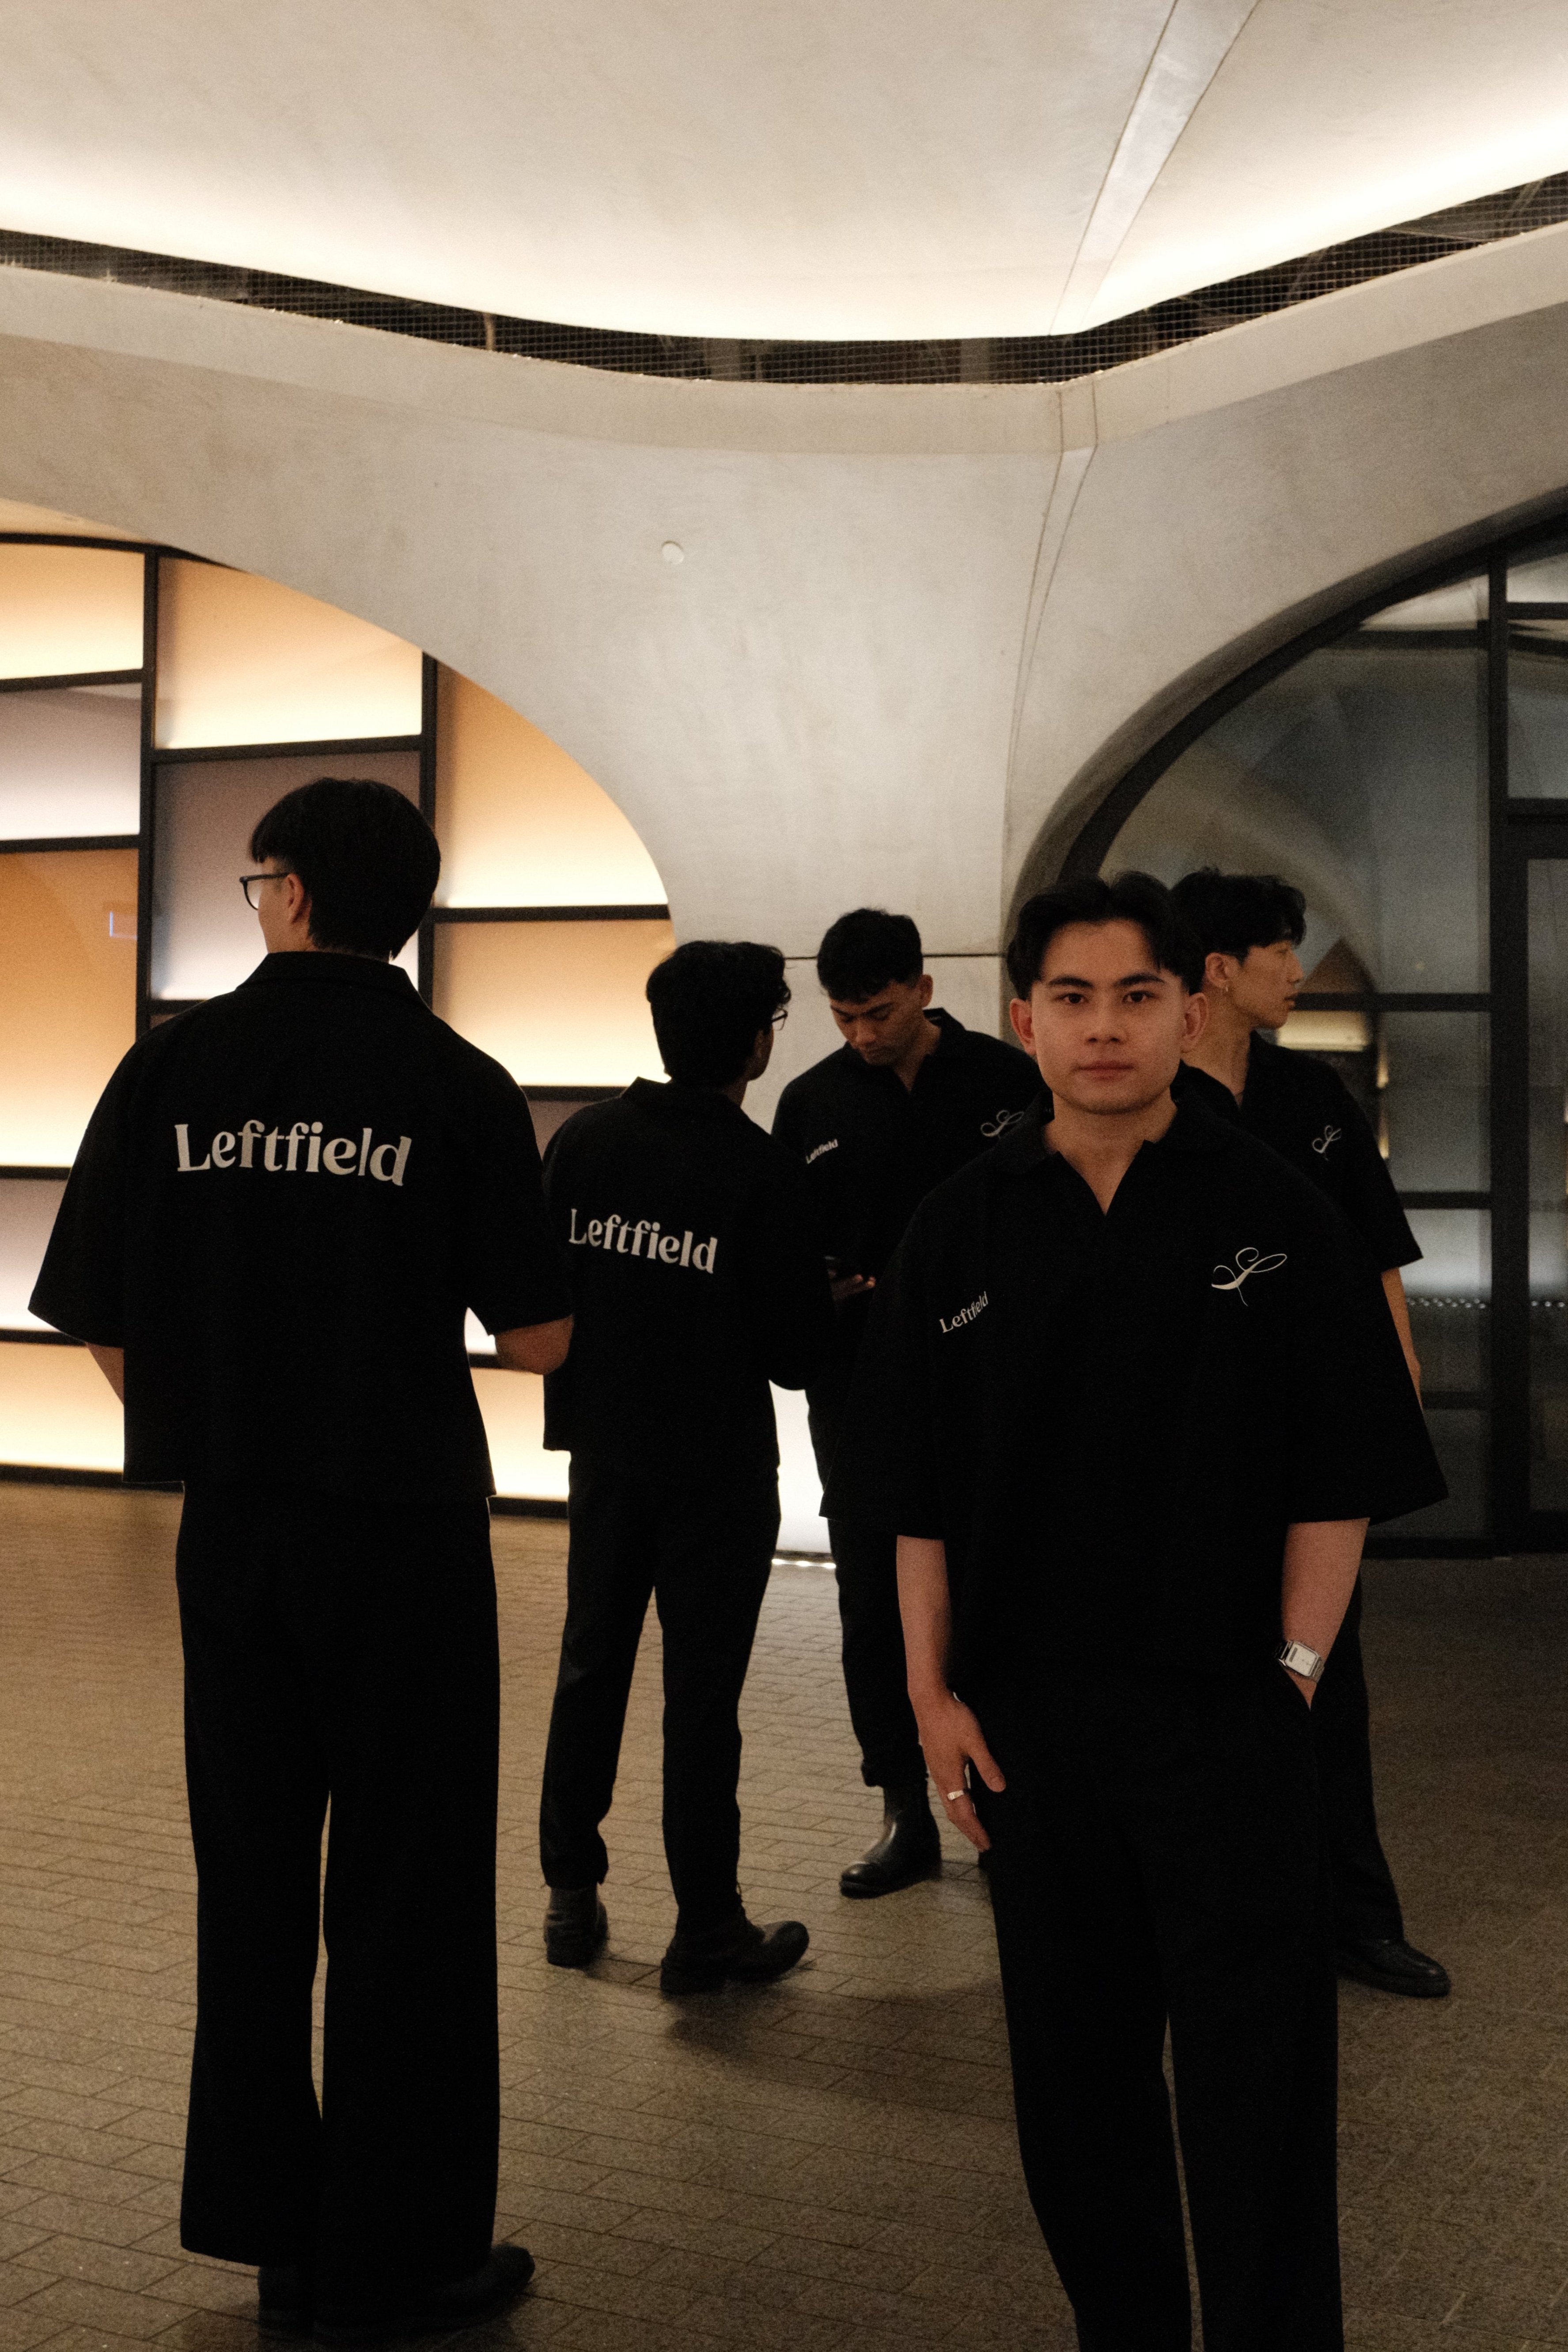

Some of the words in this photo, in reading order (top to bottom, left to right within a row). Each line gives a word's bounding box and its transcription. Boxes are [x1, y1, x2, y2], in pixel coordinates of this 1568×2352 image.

[174, 1119, 412, 1186] Leftfield
[568, 1208, 718, 1274] Leftfield
[939, 1290, 989, 1333] Leftfield
